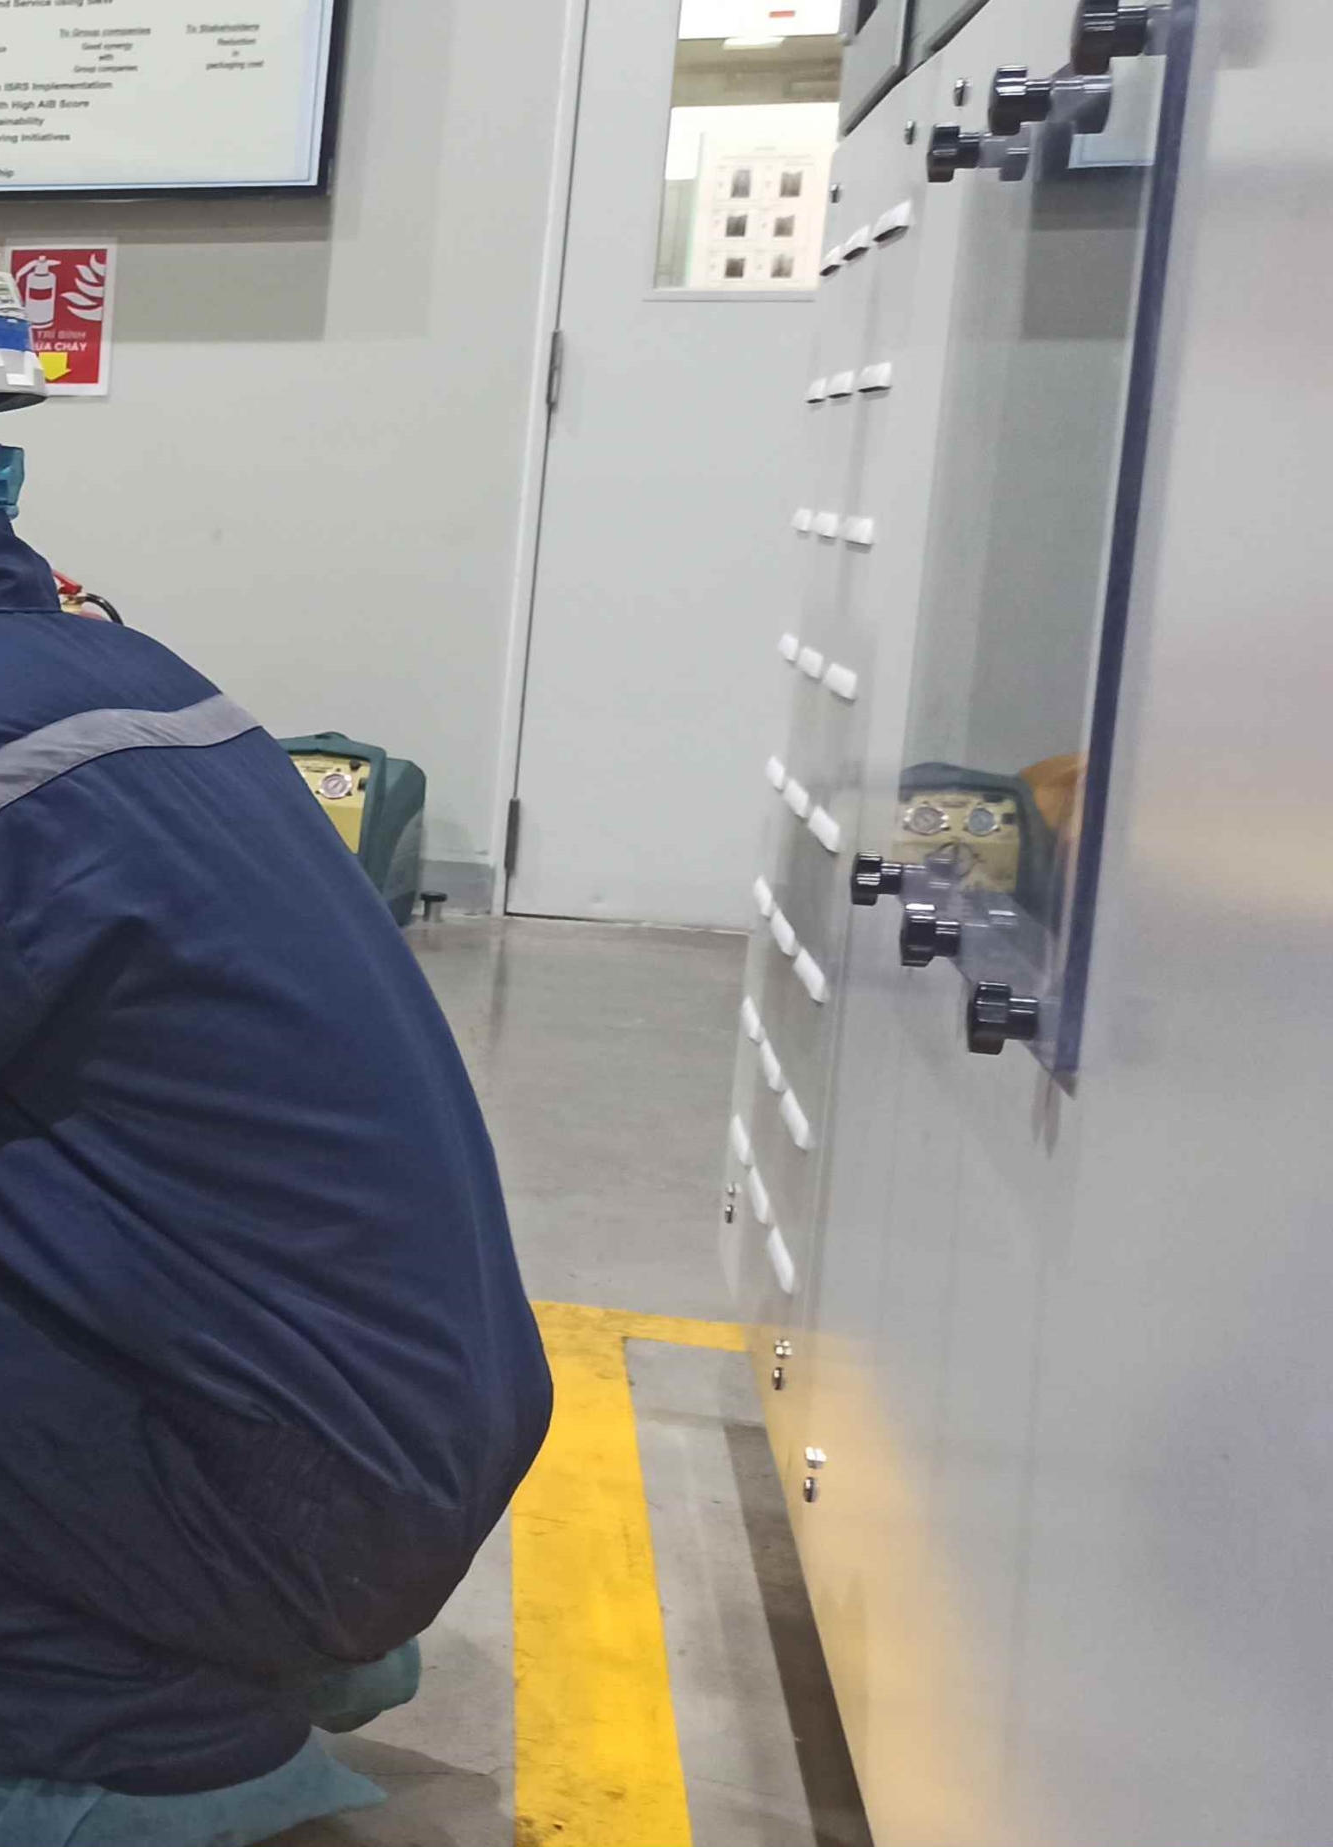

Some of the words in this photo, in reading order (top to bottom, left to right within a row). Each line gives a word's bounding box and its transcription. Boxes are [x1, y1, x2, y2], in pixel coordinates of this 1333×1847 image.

[60, 29, 70, 38] To
[72, 28, 100, 38] Group
[102, 27, 151, 36] companies
[186, 24, 197, 34] To
[32, 81, 113, 93] Implementation
[12, 101, 35, 111] High
[59, 99, 90, 109] Score
[21, 132, 71, 142] Initiatives
